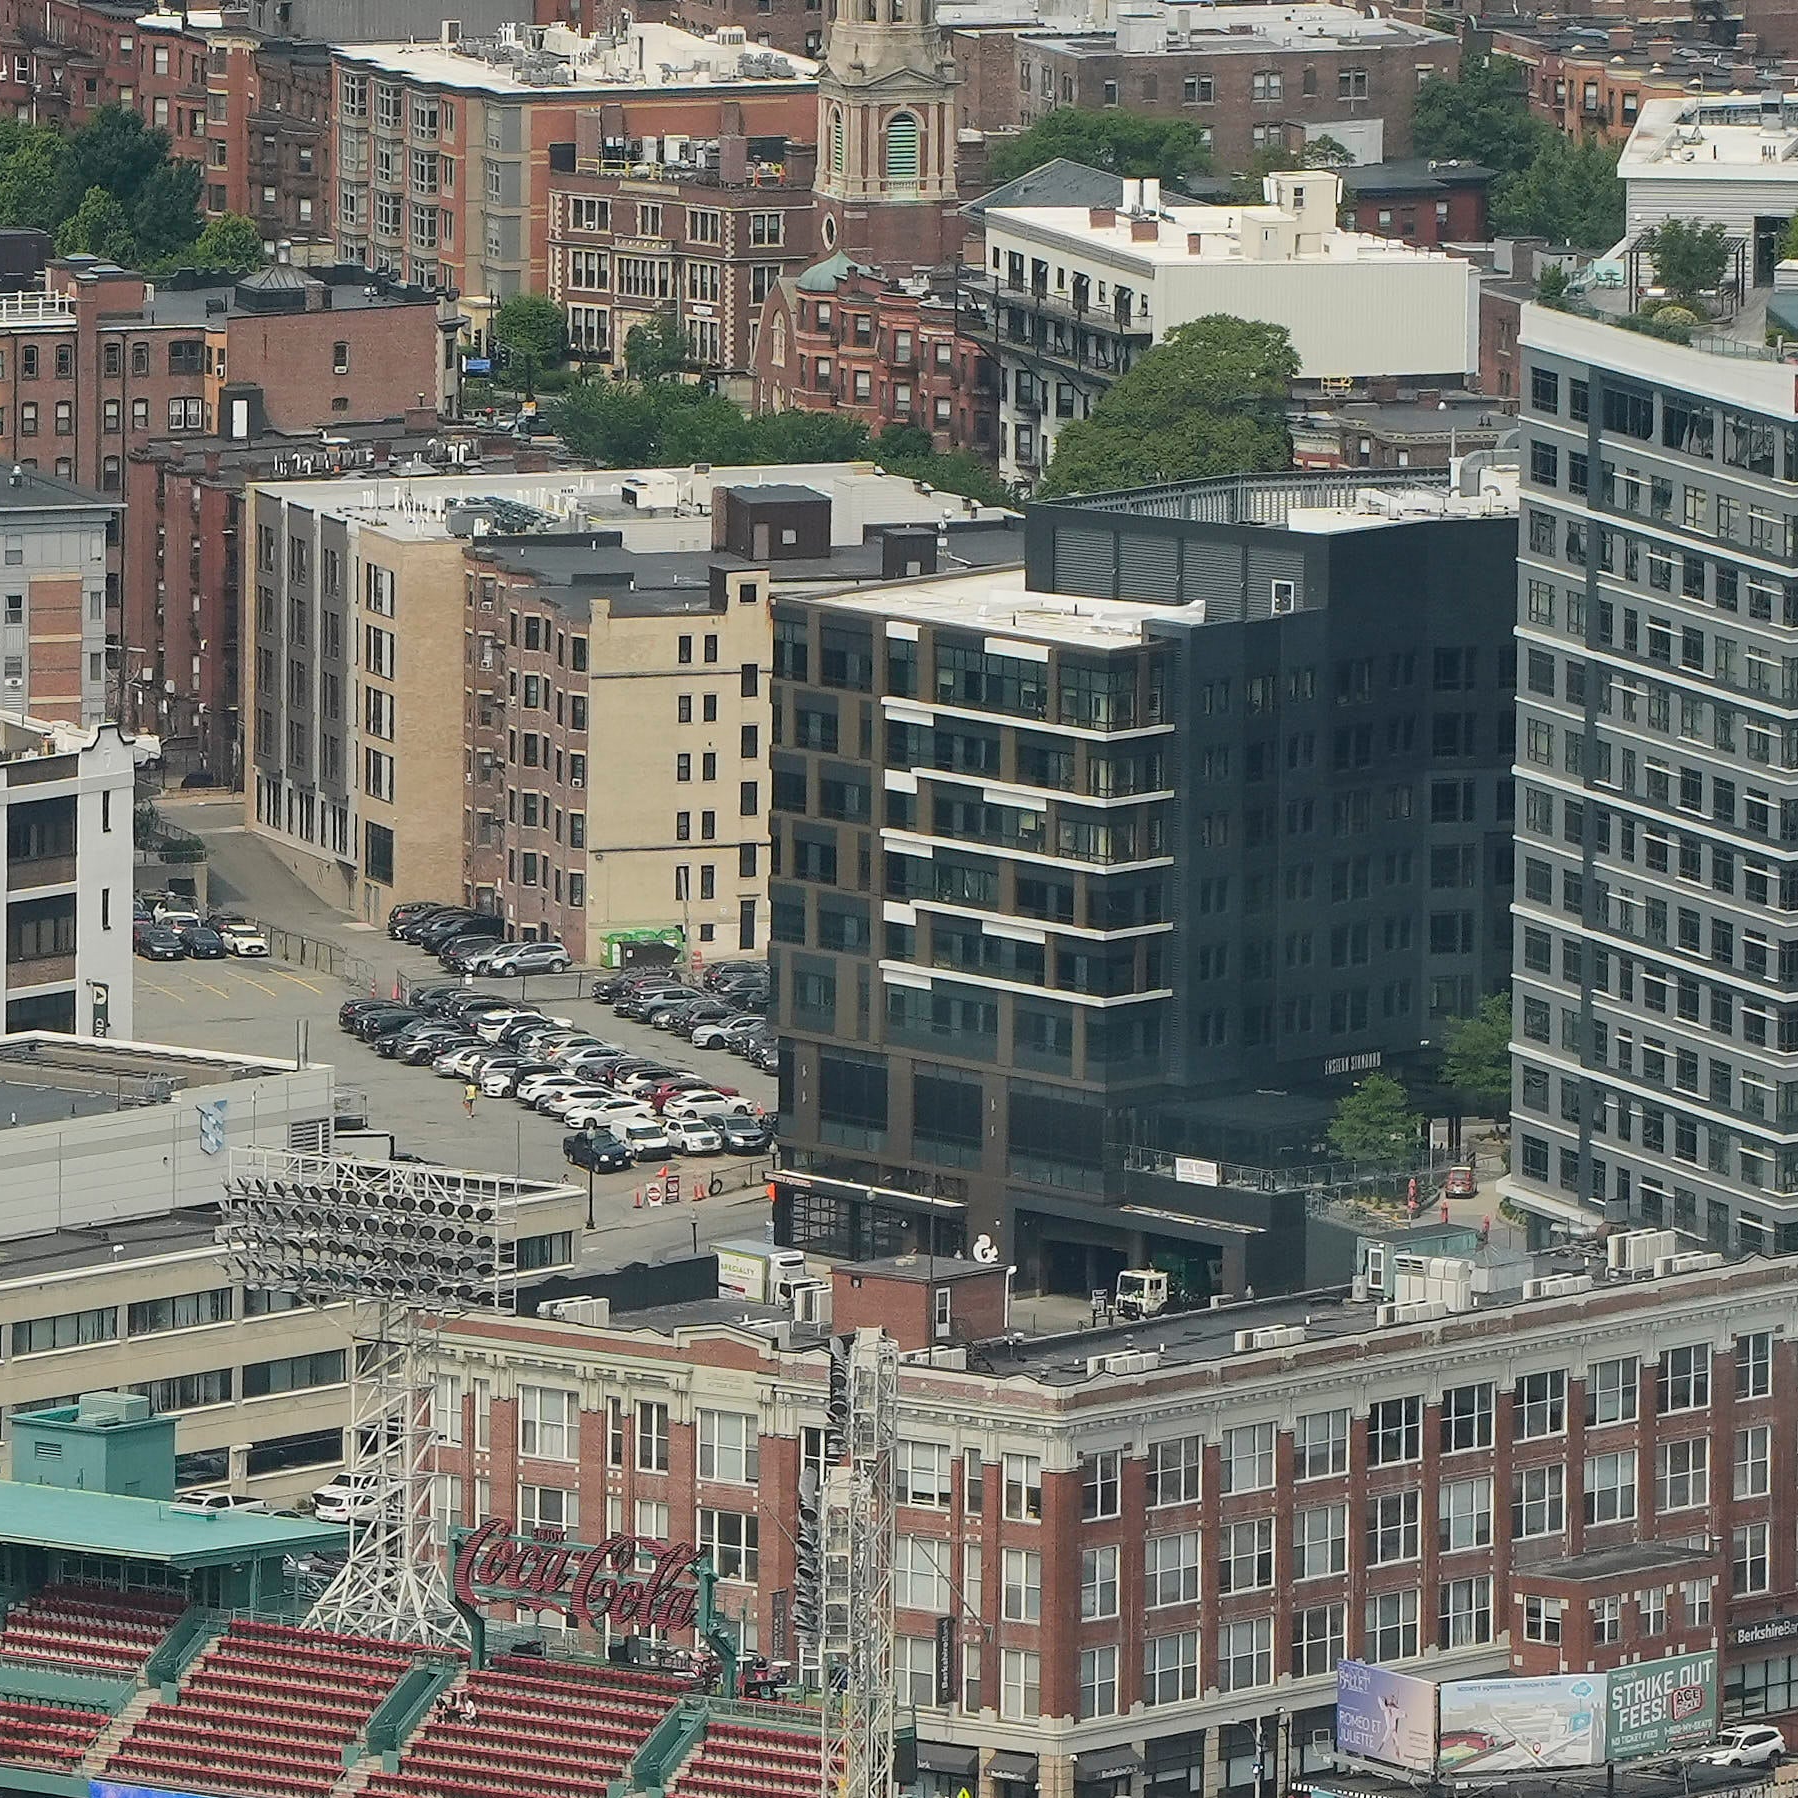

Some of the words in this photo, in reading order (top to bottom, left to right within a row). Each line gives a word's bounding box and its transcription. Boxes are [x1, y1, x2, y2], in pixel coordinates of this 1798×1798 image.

[454, 1518, 702, 1632] Coca-Cola
[1612, 1671, 1674, 1710] STRIKE
[1680, 1659, 1713, 1688] OUT
[1339, 1711, 1370, 1730] ROMEO
[1619, 1697, 1667, 1732] FEES!
[1340, 1727, 1374, 1748] JULIETTE
